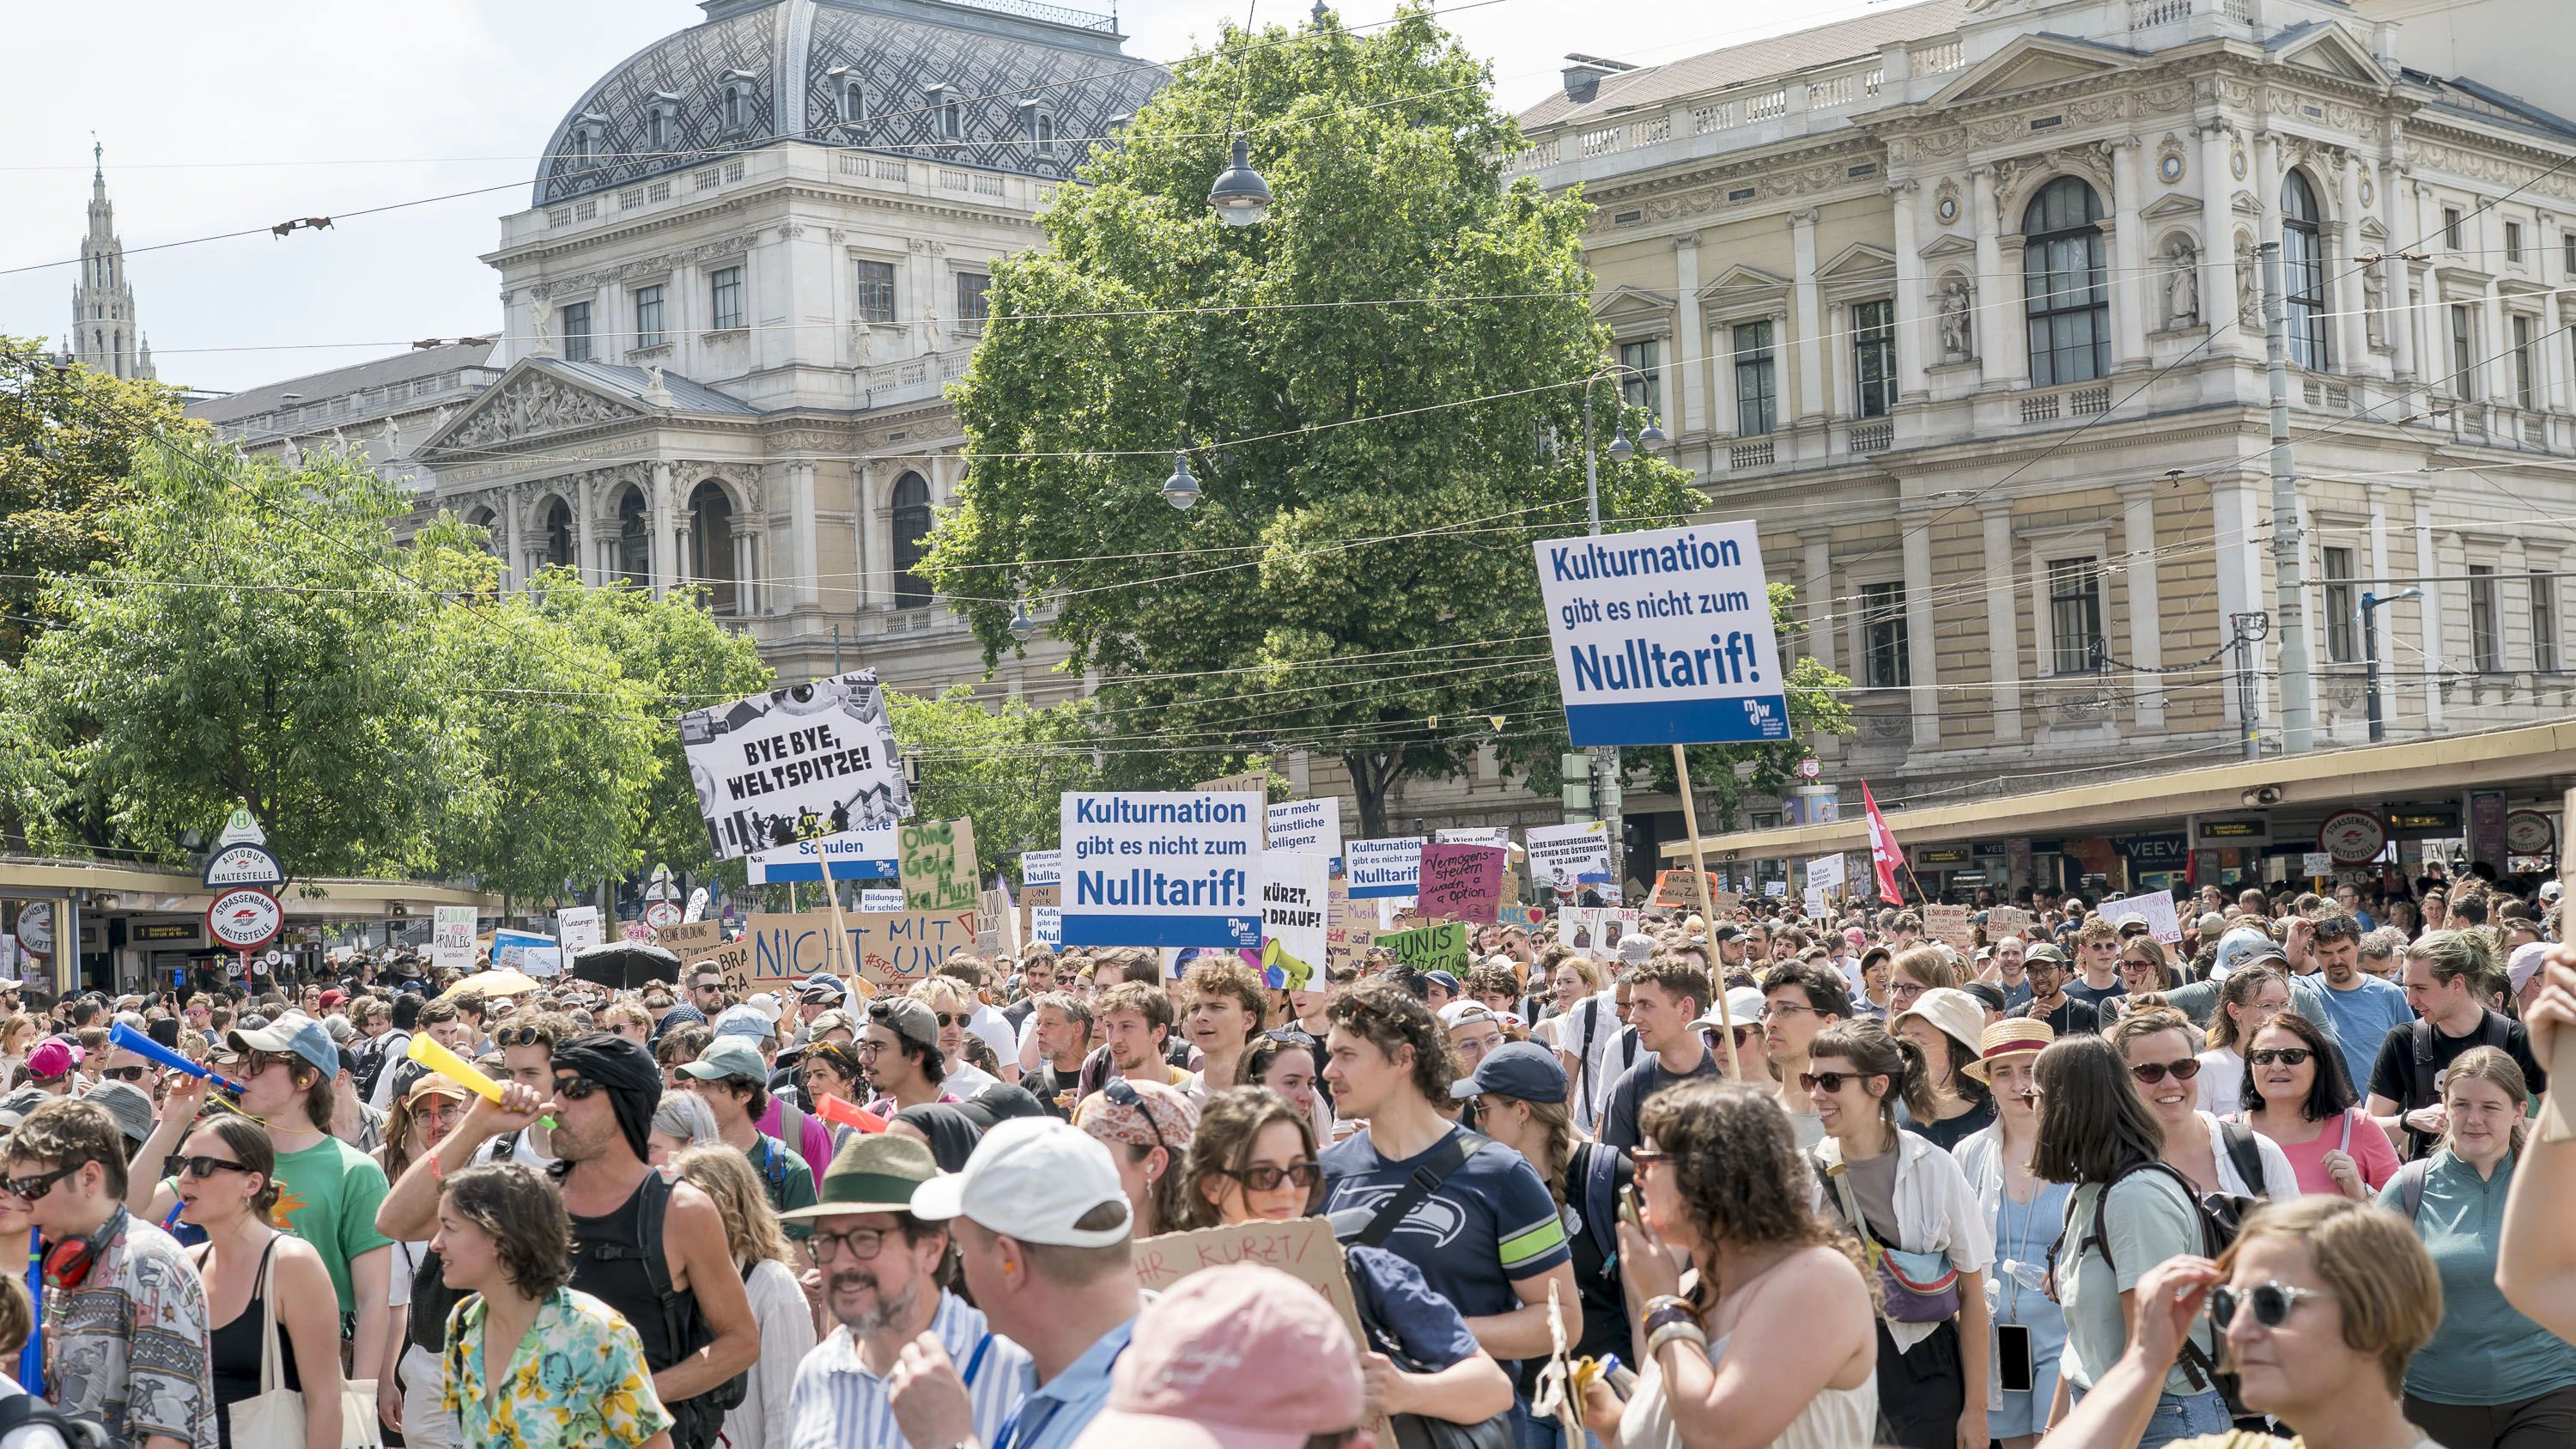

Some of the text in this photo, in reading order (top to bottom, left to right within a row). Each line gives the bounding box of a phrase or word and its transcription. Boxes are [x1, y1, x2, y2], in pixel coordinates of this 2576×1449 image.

[1551, 533, 1741, 581] Kulturnation
[1562, 590, 1749, 630] gibt es nicht zum
[1570, 630, 1760, 691] Nulltarif!
[744, 724, 841, 766] BYE BYE,
[726, 746, 872, 801] WELTSPITZE!
[1077, 796, 1246, 824] Kulturnation
[1269, 802, 1320, 817] nur mehr
[235, 813, 247, 825] H
[2326, 817, 2379, 835] STRASSENBAHN
[903, 822, 954, 849] Ohne
[1548, 836, 1605, 847] BUNDESREGIERUNG,
[799, 840, 864, 855] Schulen
[1076, 836, 1247, 859] gibt es nicht zum
[1352, 840, 1421, 853] Kulturnation
[1540, 849, 1558, 857] SEHEN
[1571, 844, 1607, 855] ÖSTERREICH
[2128, 841, 2179, 856] VEEV
[2330, 843, 2377, 858] HALTESTELLE
[222, 850, 265, 865] AUTOBUS
[904, 844, 955, 879] Geld
[1353, 857, 1369, 866] gibt
[1425, 851, 1496, 870] Vermögens-
[1564, 855, 1591, 864] JAHREN?
[215, 871, 273, 882] HALTESTELLE
[1436, 863, 1483, 880] steuern
[1811, 868, 1829, 876] Kultur
[1812, 874, 1831, 882] Nation
[1078, 868, 1246, 907] Nulltarif!
[1812, 880, 1829, 888] retten
[907, 886, 931, 910] ka
[1032, 888, 1050, 897] UNI
[1437, 895, 1444, 904] a
[216, 894, 275, 916] STRASSENBAHN
[1349, 903, 1379, 919] Musik
[2115, 899, 2140, 916] YOU
[2144, 894, 2172, 910] THINK
[439, 909, 475, 922] BILDUNG
[561, 913, 594, 927] Kürzungen
[1271, 909, 1321, 928] DRAUF!
[1581, 910, 1596, 920] MIT
[1990, 909, 2028, 924] UNI WIEN
[218, 922, 272, 941] HALTESTELLE
[659, 925, 707, 942] KEINE BILDUNG
[1990, 921, 2011, 932] BRENNT
[756, 916, 951, 977] NICHT MIT
